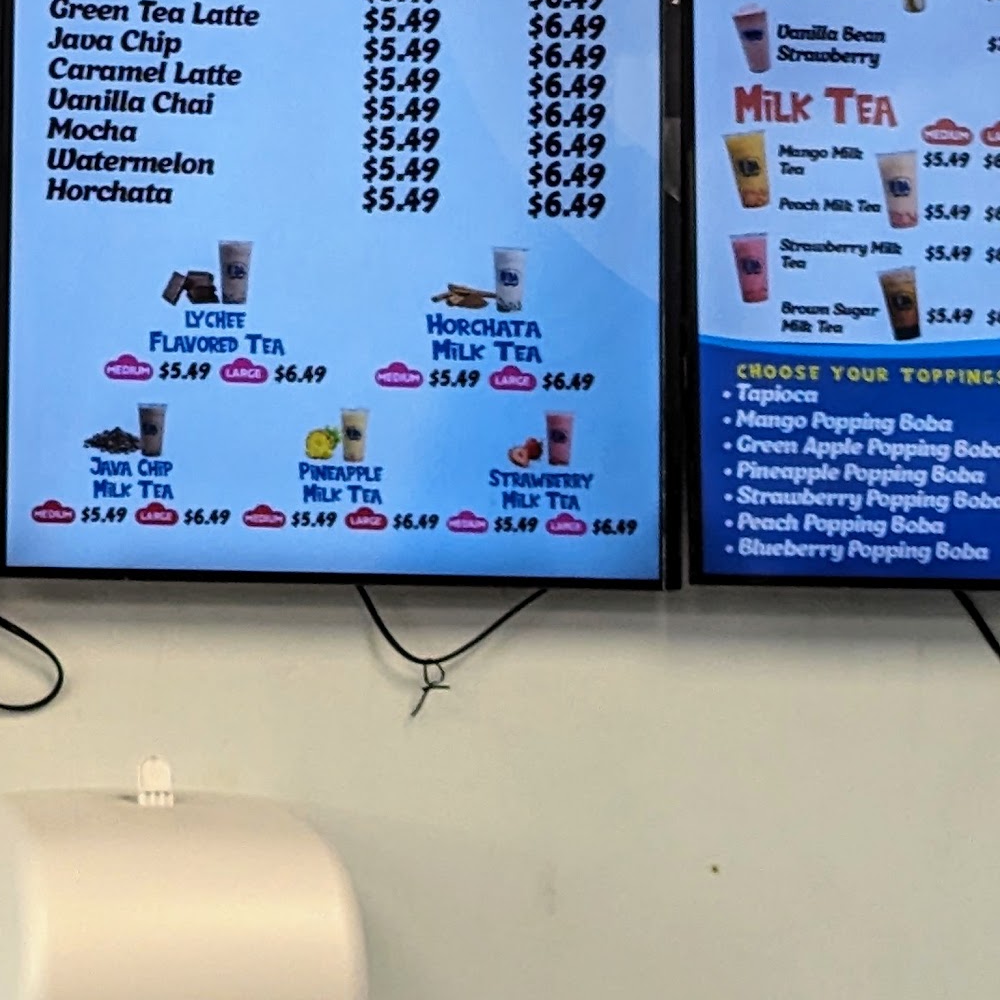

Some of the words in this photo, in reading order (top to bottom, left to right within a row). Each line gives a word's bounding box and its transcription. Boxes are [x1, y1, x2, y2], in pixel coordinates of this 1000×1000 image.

[138, 0, 185, 24] Tea
[192, 2, 260, 26] Latte
[48, 27, 113, 50] Java
[120, 30, 182, 58] Chip
[48, 57, 166, 82] Caramel
[174, 62, 242, 86] Latte
[48, 88, 144, 112] Vanilla
[152, 92, 214, 114] Chai
[47, 118, 137, 142] Mocha
[47, 148, 214, 174] Watermelon
[46, 178, 172, 204] Horchata
[159, 362, 211, 380] $5.49
[274, 365, 327, 383] $6.49
[737, 383, 819, 407] Tapioca
[736, 410, 807, 433] Mango
[811, 412, 895, 435] Popping
[899, 413, 953, 433] Boba
[737, 436, 798, 454] Green
[803, 438, 863, 459] Apple
[867, 438, 951, 462] Popping
[737, 461, 840, 485] Pineapple
[844, 464, 927, 487] Popping
[932, 465, 986, 485] Boba
[738, 539, 844, 562] Blueberry
[848, 541, 932, 564] Popping
[936, 542, 990, 561] Boba
